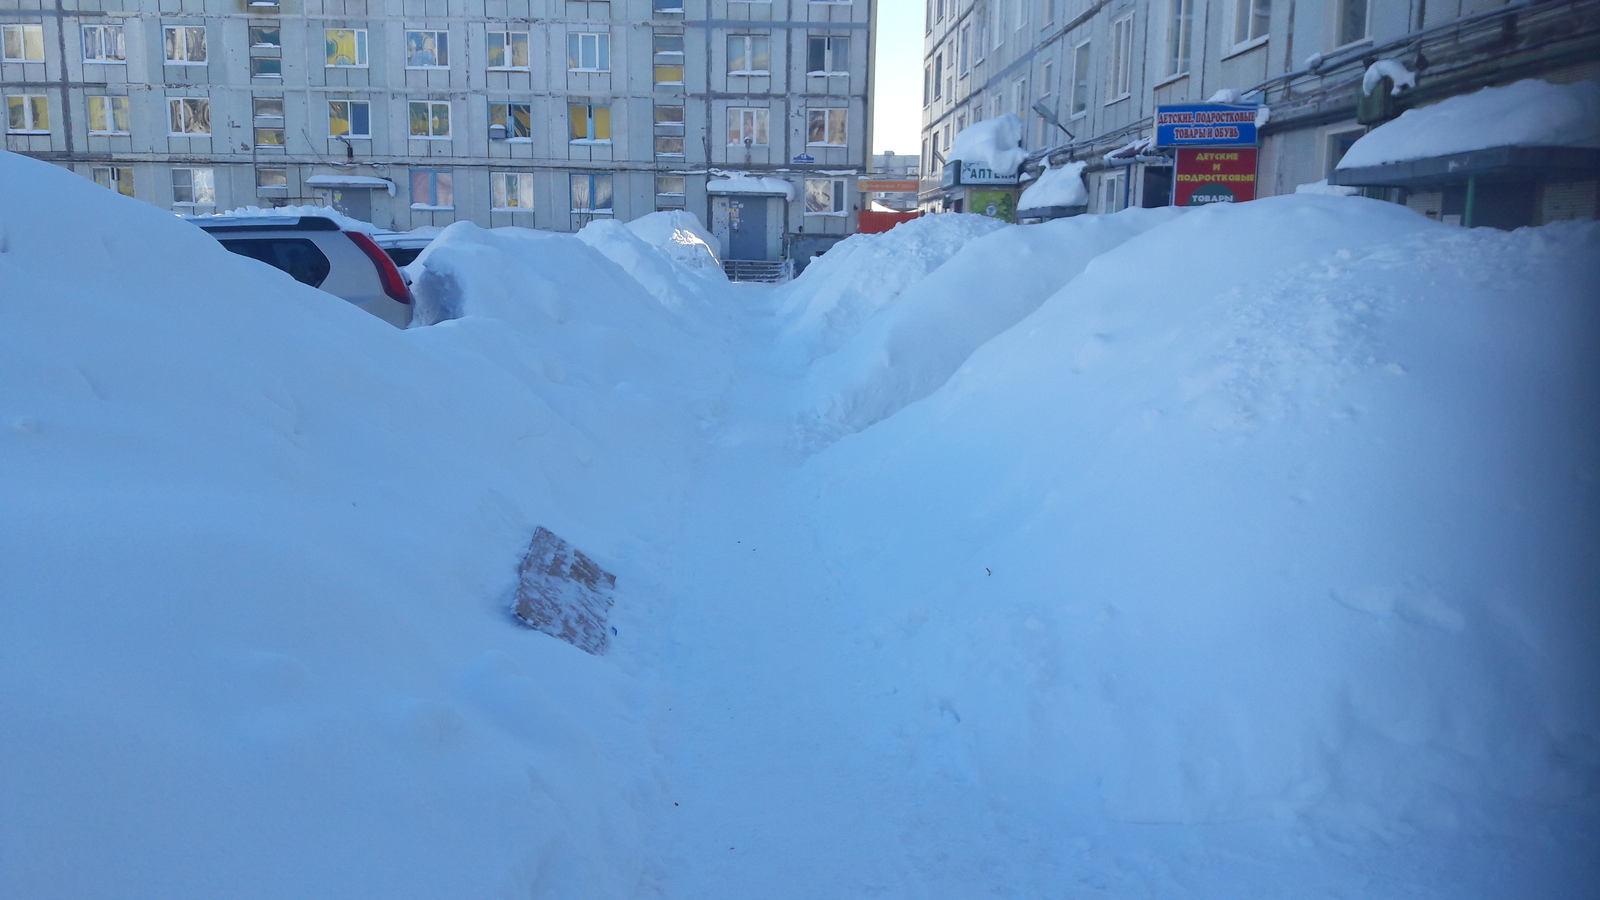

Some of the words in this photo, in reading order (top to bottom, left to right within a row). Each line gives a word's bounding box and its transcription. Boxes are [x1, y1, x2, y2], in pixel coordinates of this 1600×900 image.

[1158, 112, 1194, 126] ДЕТСКИЕ,
[1195, 110, 1256, 125] ПОДРОСТКОВЫЕ
[1174, 127, 1205, 140] ТОВАРЫ
[1206, 127, 1213, 139] И
[1214, 126, 1240, 139] ОБУВЬ
[1196, 152, 1239, 161] ДЕТСКИЕ
[1212, 163, 1221, 171] И
[970, 168, 1016, 179] АПТЕ
[1177, 173, 1255, 182] ПОДРОСТКОВЫЕ
[1192, 194, 1234, 203] ТОВАРЫ
